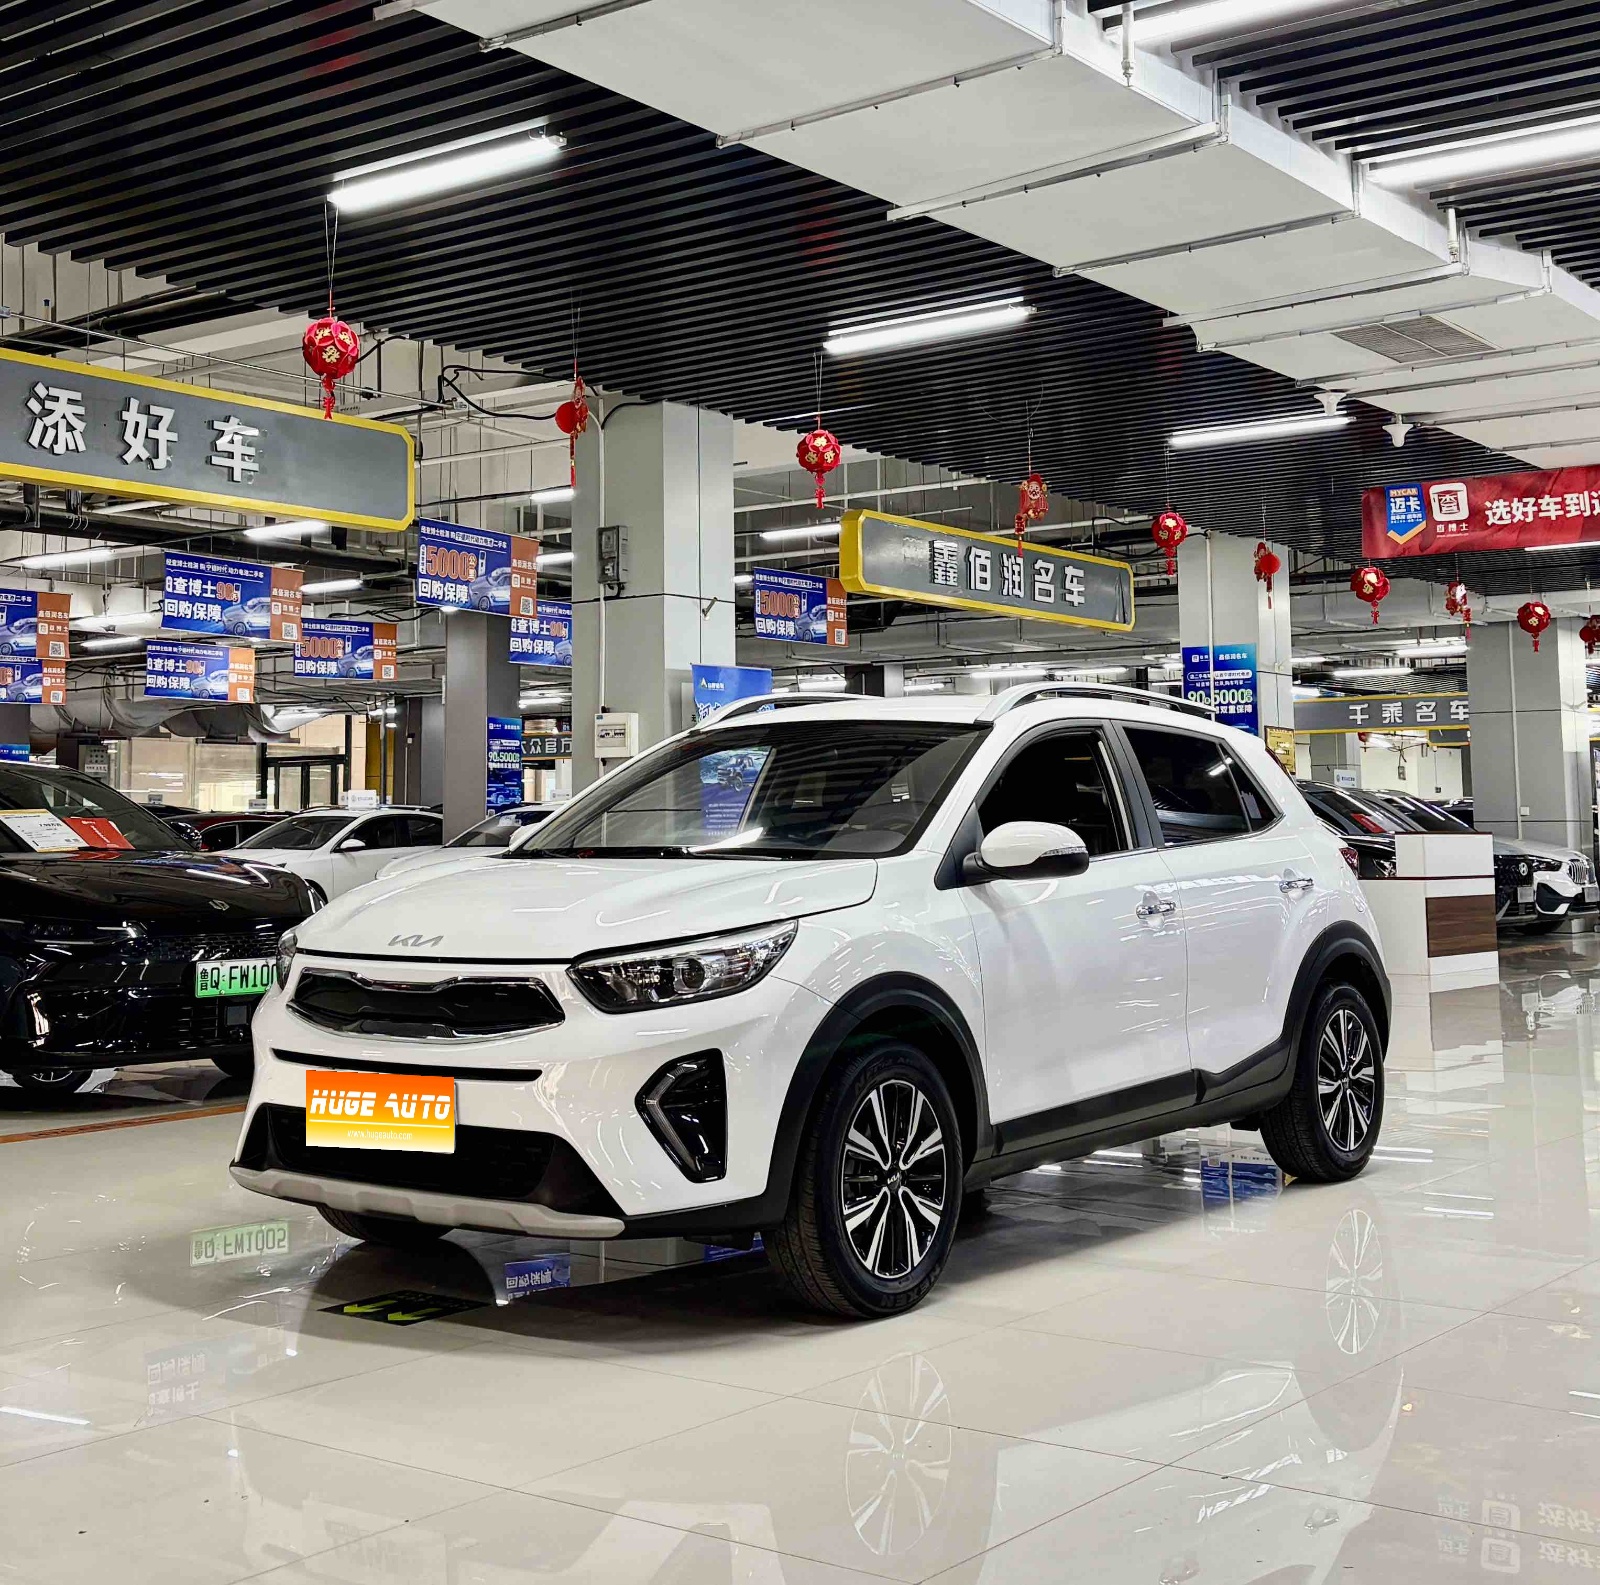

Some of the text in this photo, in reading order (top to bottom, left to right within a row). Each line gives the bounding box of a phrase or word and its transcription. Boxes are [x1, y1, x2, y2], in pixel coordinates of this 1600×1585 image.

[26, 380, 259, 482] 添好车
[1390, 496, 1420, 514] 迈卡
[929, 539, 1085, 607] 鑫佰润名车
[418, 578, 468, 604] 回购保障
[164, 599, 222, 621] 回购保障
[756, 617, 796, 637] 回购保障
[510, 638, 555, 656] 回购保障
[294, 659, 338, 675] 回购保障
[146, 674, 192, 689] 回购保障
[1348, 700, 1470, 725] 千乘名车
[388, 934, 444, 948] KIA
